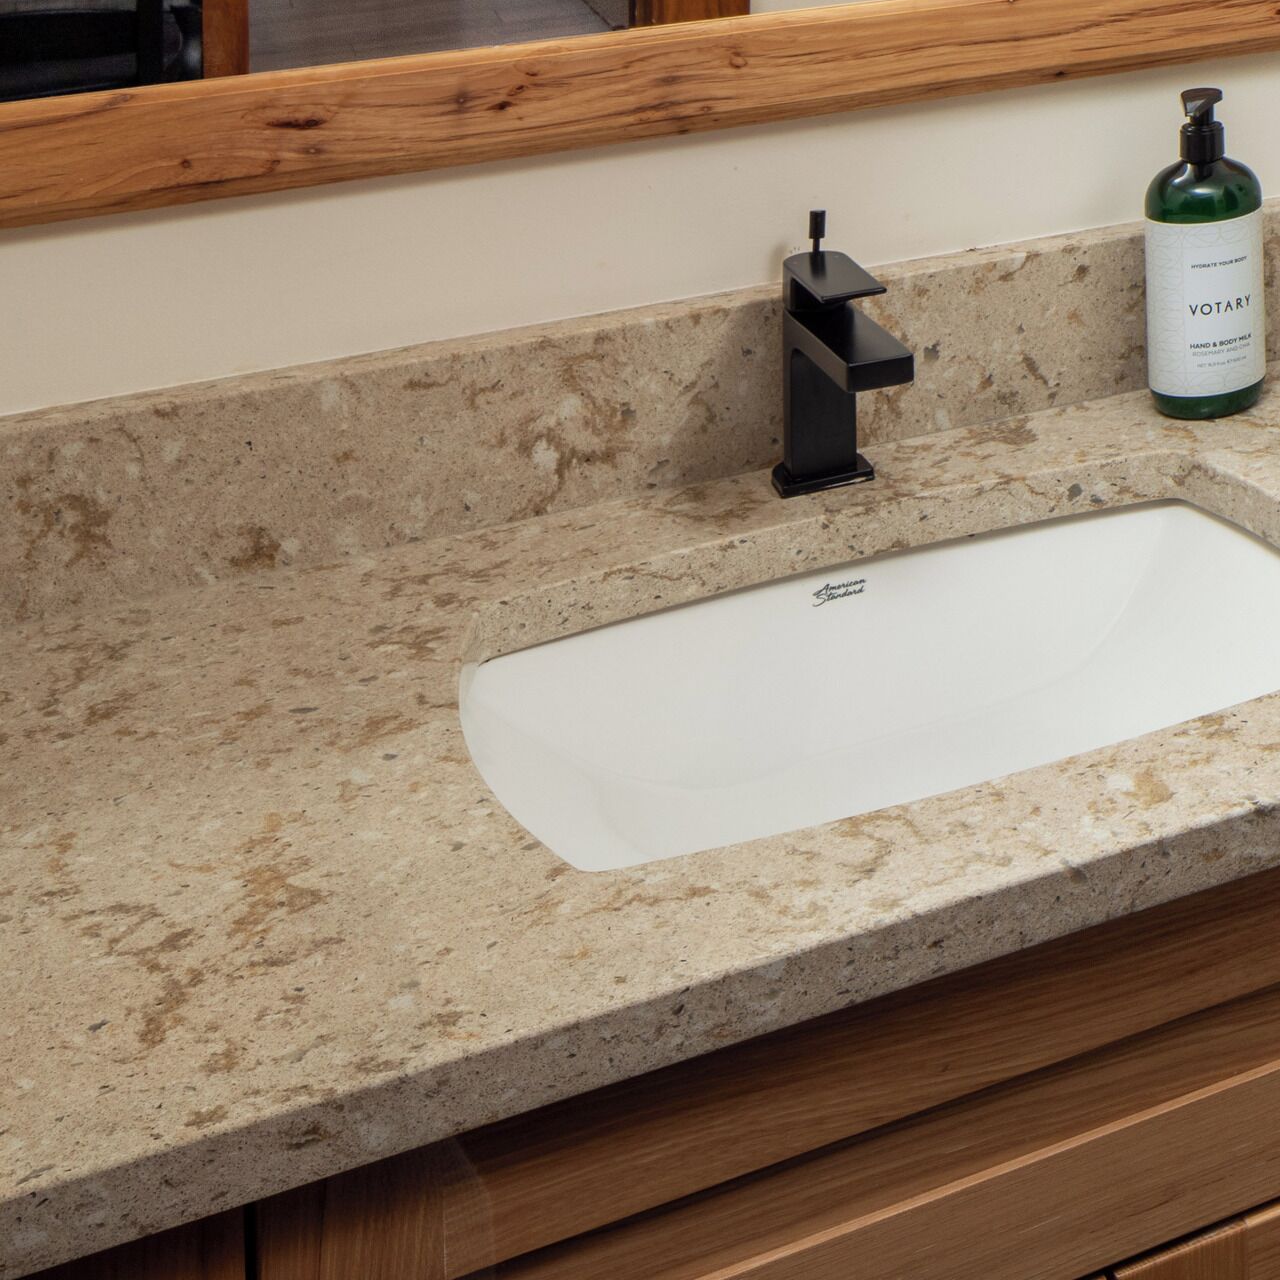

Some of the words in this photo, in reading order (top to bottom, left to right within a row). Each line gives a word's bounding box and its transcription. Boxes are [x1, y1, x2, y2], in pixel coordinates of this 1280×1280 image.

[1234, 255, 1247, 263] BODY
[1189, 293, 1251, 316] VOTARY
[1219, 337, 1238, 347] BODY
[1238, 332, 1252, 342] MILK
[812, 578, 867, 596] American
[812, 585, 865, 607] Standard
